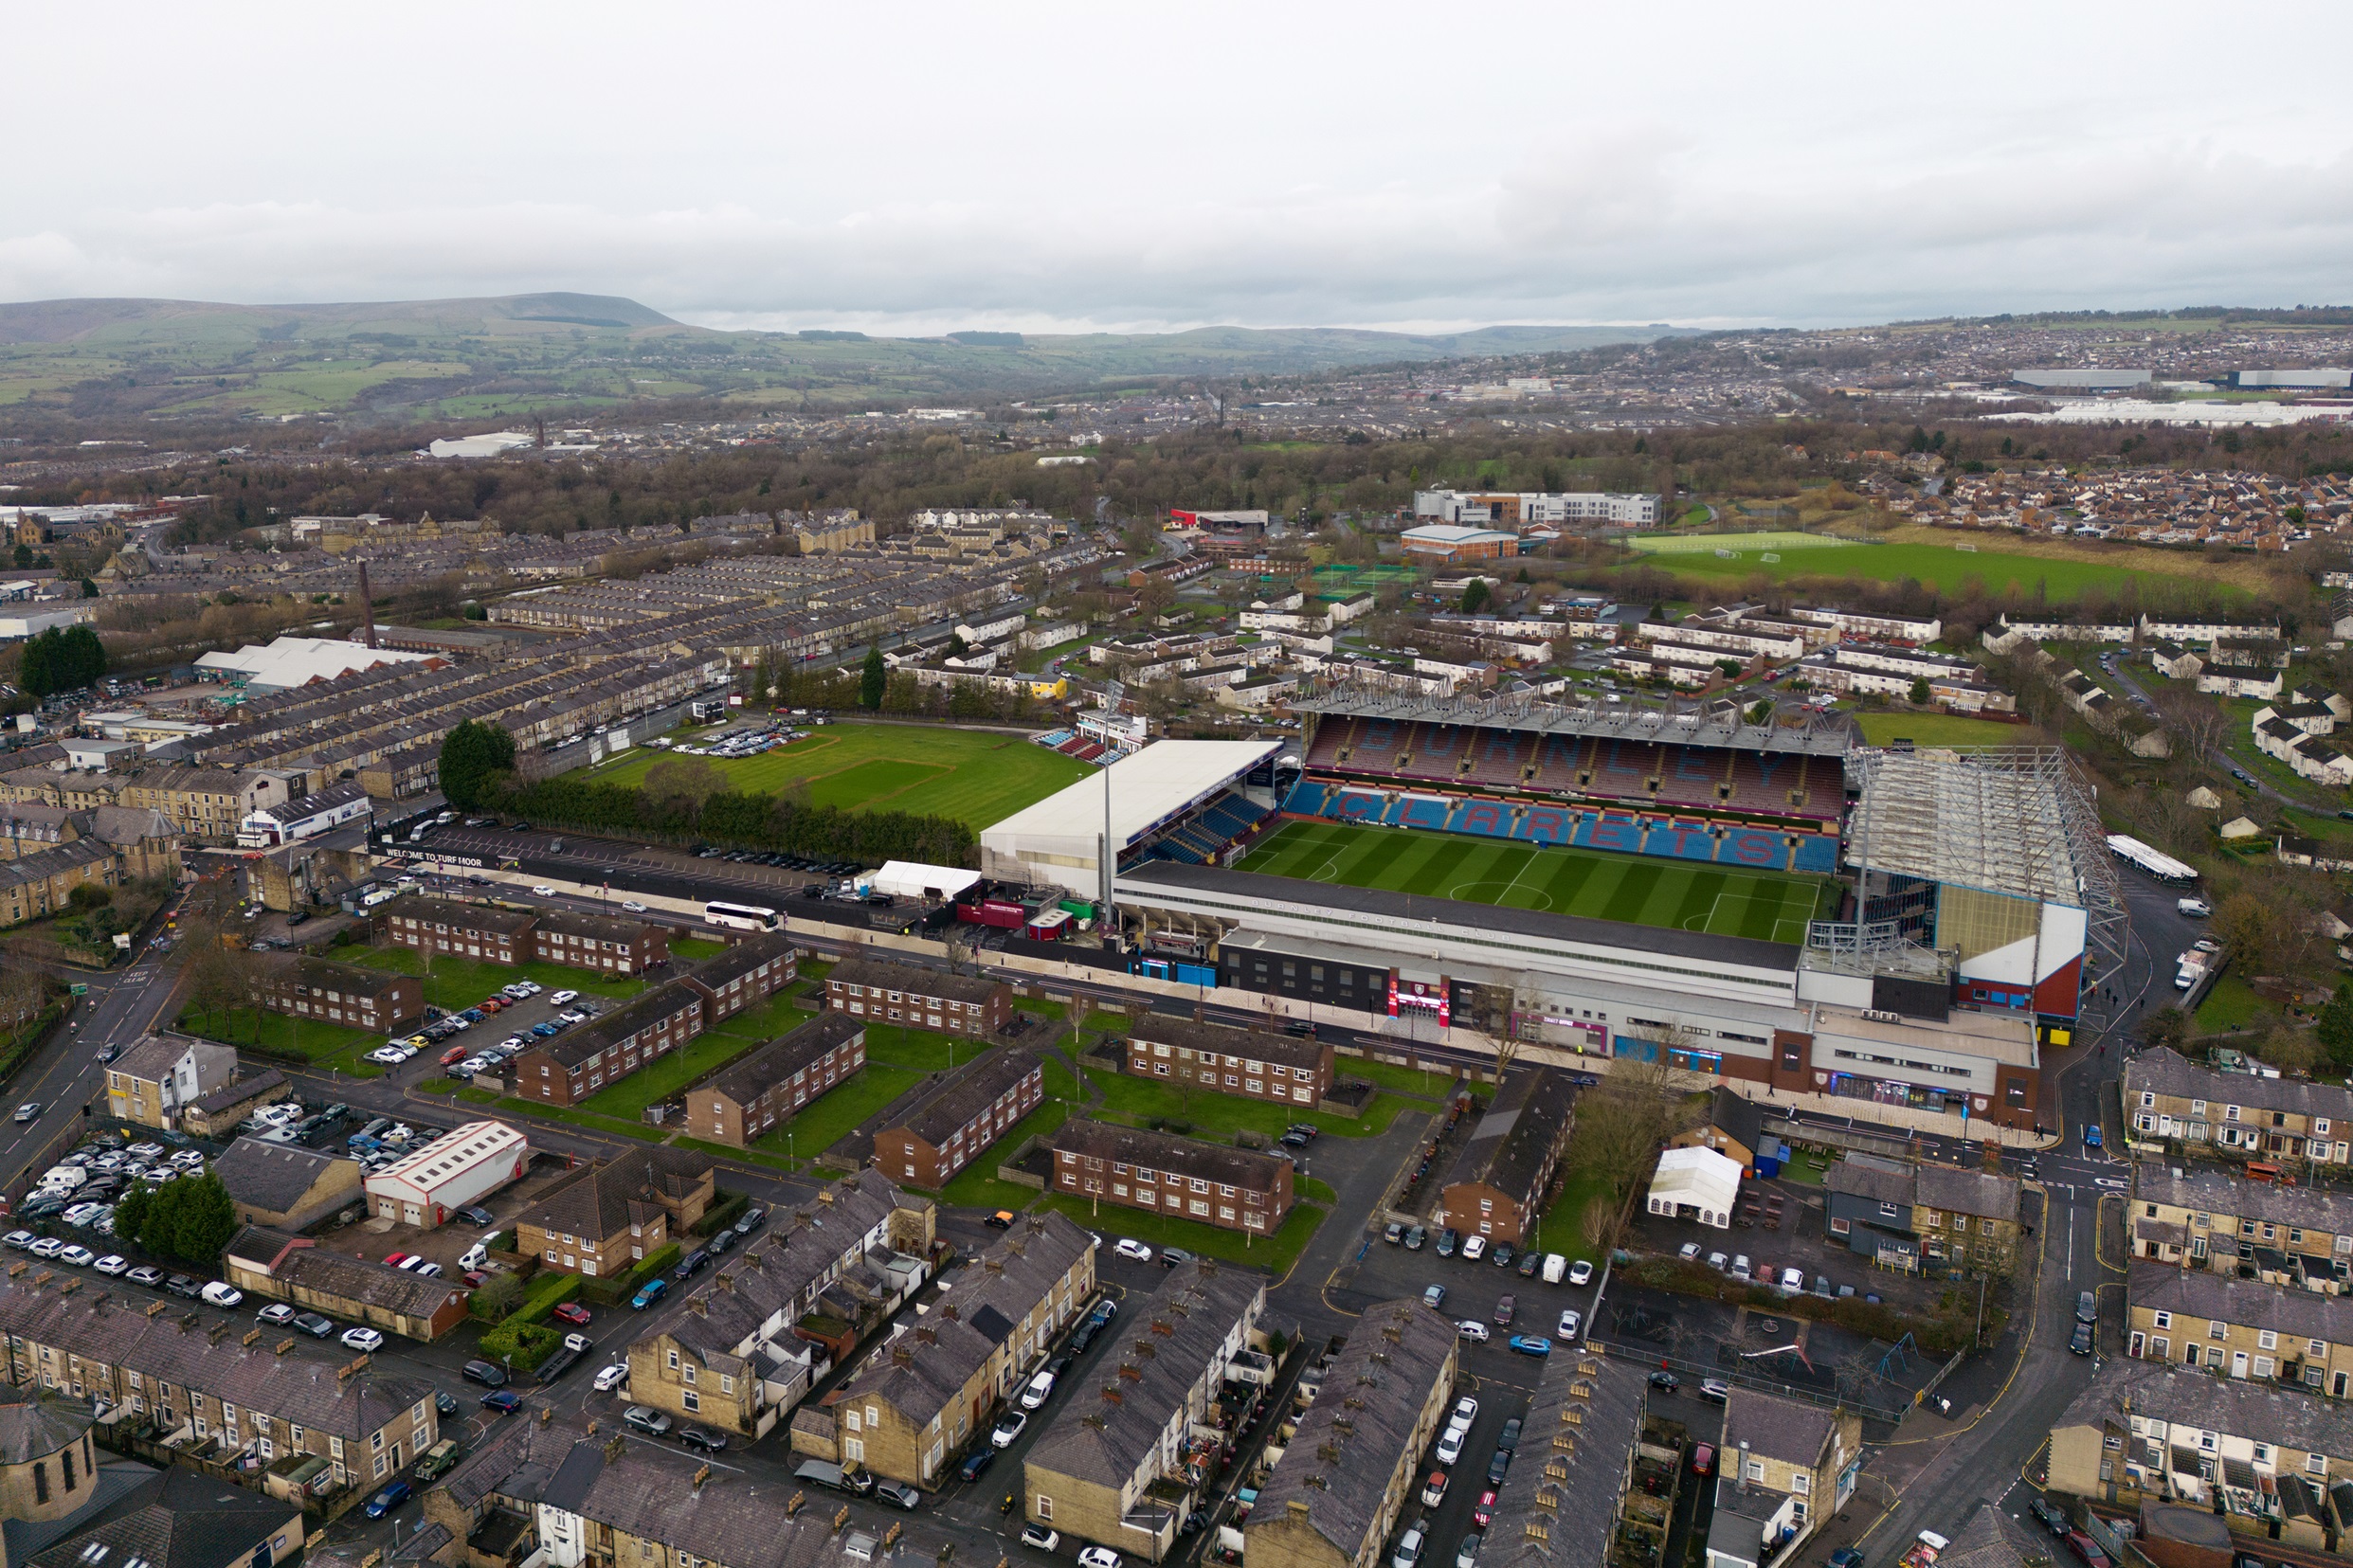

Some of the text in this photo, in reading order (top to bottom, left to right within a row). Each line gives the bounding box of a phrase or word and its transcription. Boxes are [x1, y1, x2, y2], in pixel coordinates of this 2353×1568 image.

[1359, 717, 1785, 787] BURNLEY
[1337, 793, 1774, 863] CLARETS
[425, 853, 436, 861] TO
[437, 855, 457, 863] TURF
[458, 856, 482, 867] MOOR
[1251, 899, 1511, 942] BURNLEY FOOTBALL CLUB
